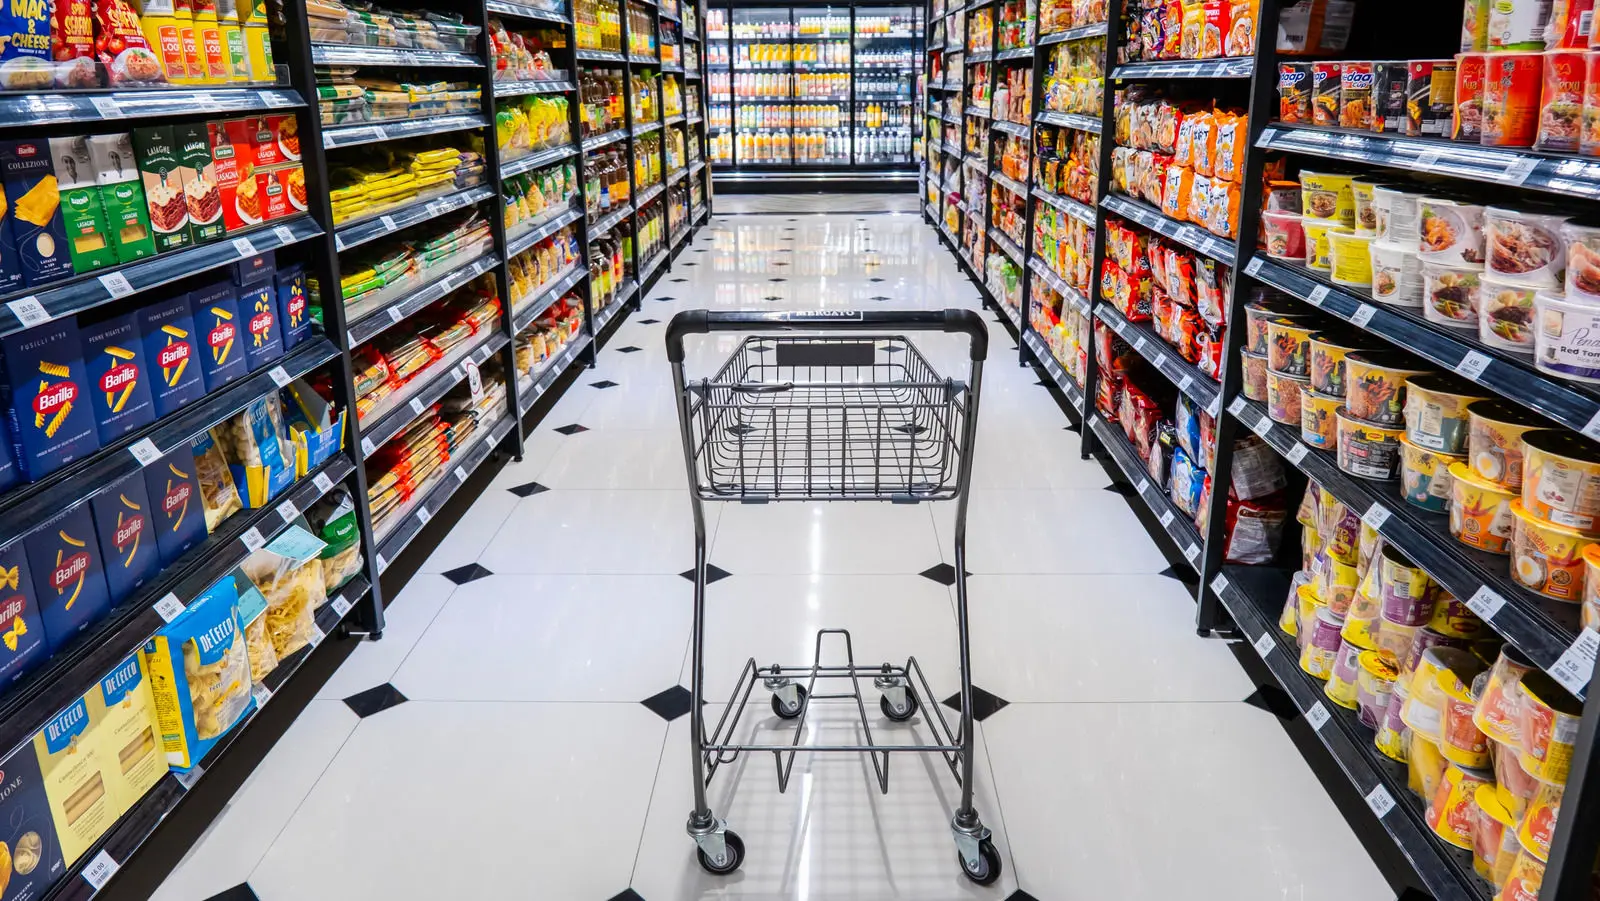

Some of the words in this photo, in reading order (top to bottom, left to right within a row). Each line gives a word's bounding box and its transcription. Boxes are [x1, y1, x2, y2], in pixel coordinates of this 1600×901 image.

[11, 0, 47, 21] MAC
[28, 18, 36, 34] &
[12, 32, 50, 50] CHEESE
[8, 160, 49, 170] COLLEZIONE
[253, 316, 274, 332] Barilla
[212, 327, 234, 345] Barilla
[162, 345, 189, 365] Barilla
[1560, 346, 1580, 354] Red
[105, 368, 136, 388] Barilla
[39, 386, 74, 410] Barilla
[166, 487, 190, 509] Barilla
[118, 519, 142, 544] Barilla
[56, 556, 87, 585] Barilla
[200, 633, 213, 653] DE
[209, 618, 233, 648] CECCO
[106, 678, 116, 696] DE
[116, 662, 138, 686] CECCO
[50, 723, 61, 742] DE
[60, 704, 83, 732] CECCO
